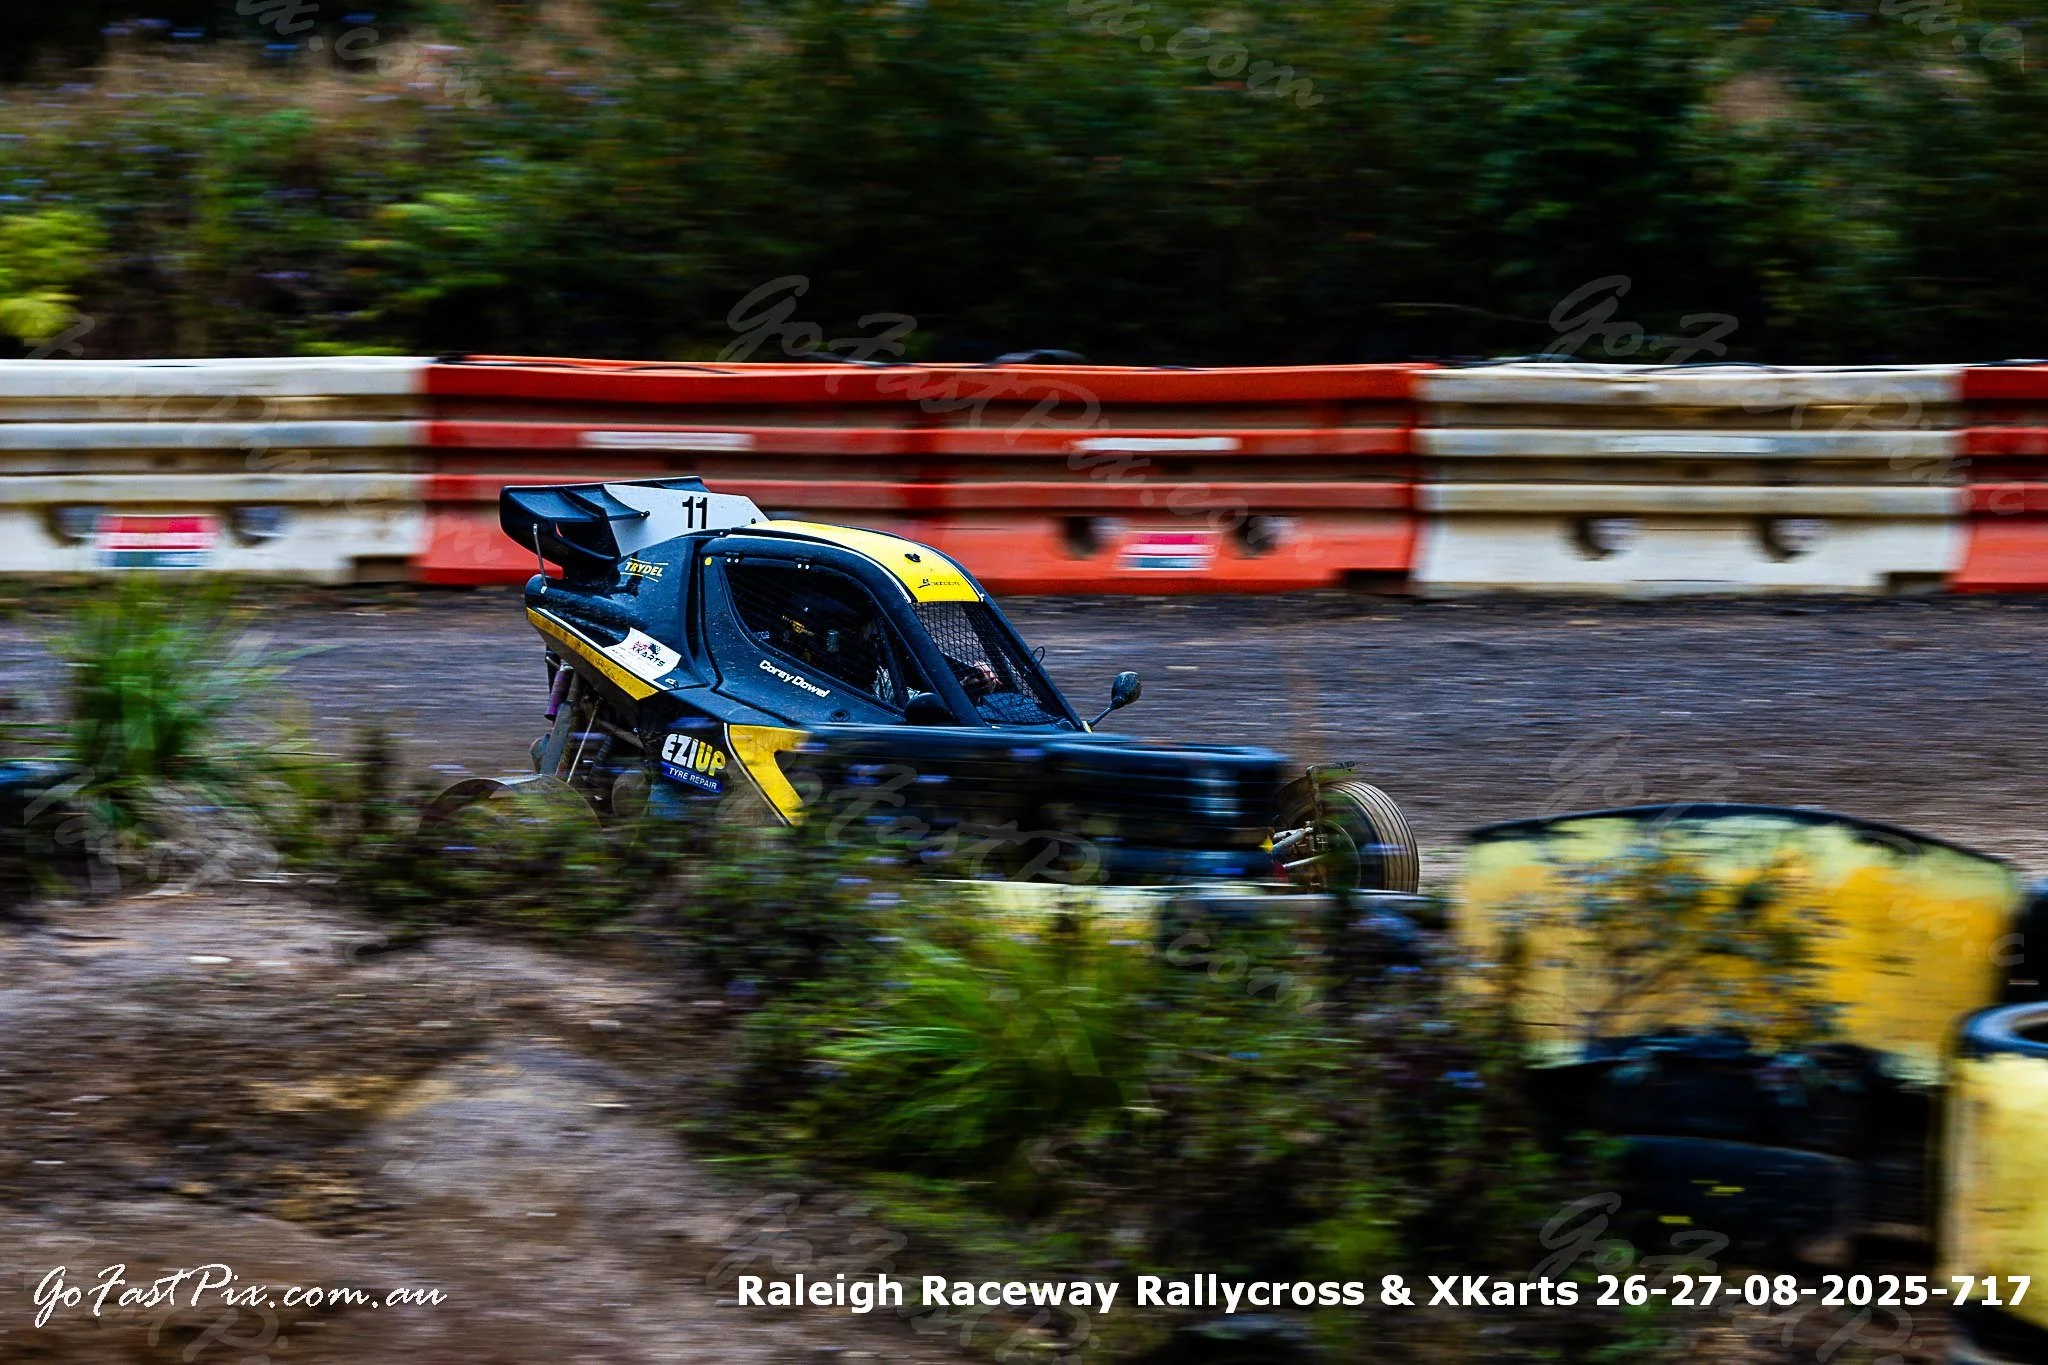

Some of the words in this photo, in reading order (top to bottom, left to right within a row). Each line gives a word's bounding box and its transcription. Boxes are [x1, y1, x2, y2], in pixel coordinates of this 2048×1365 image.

[682, 496, 708, 529] 11
[624, 561, 663, 577] TRYDEL
[760, 660, 794, 682] Corey
[669, 767, 689, 780] TYRE
[689, 774, 718, 790] REPAIR
